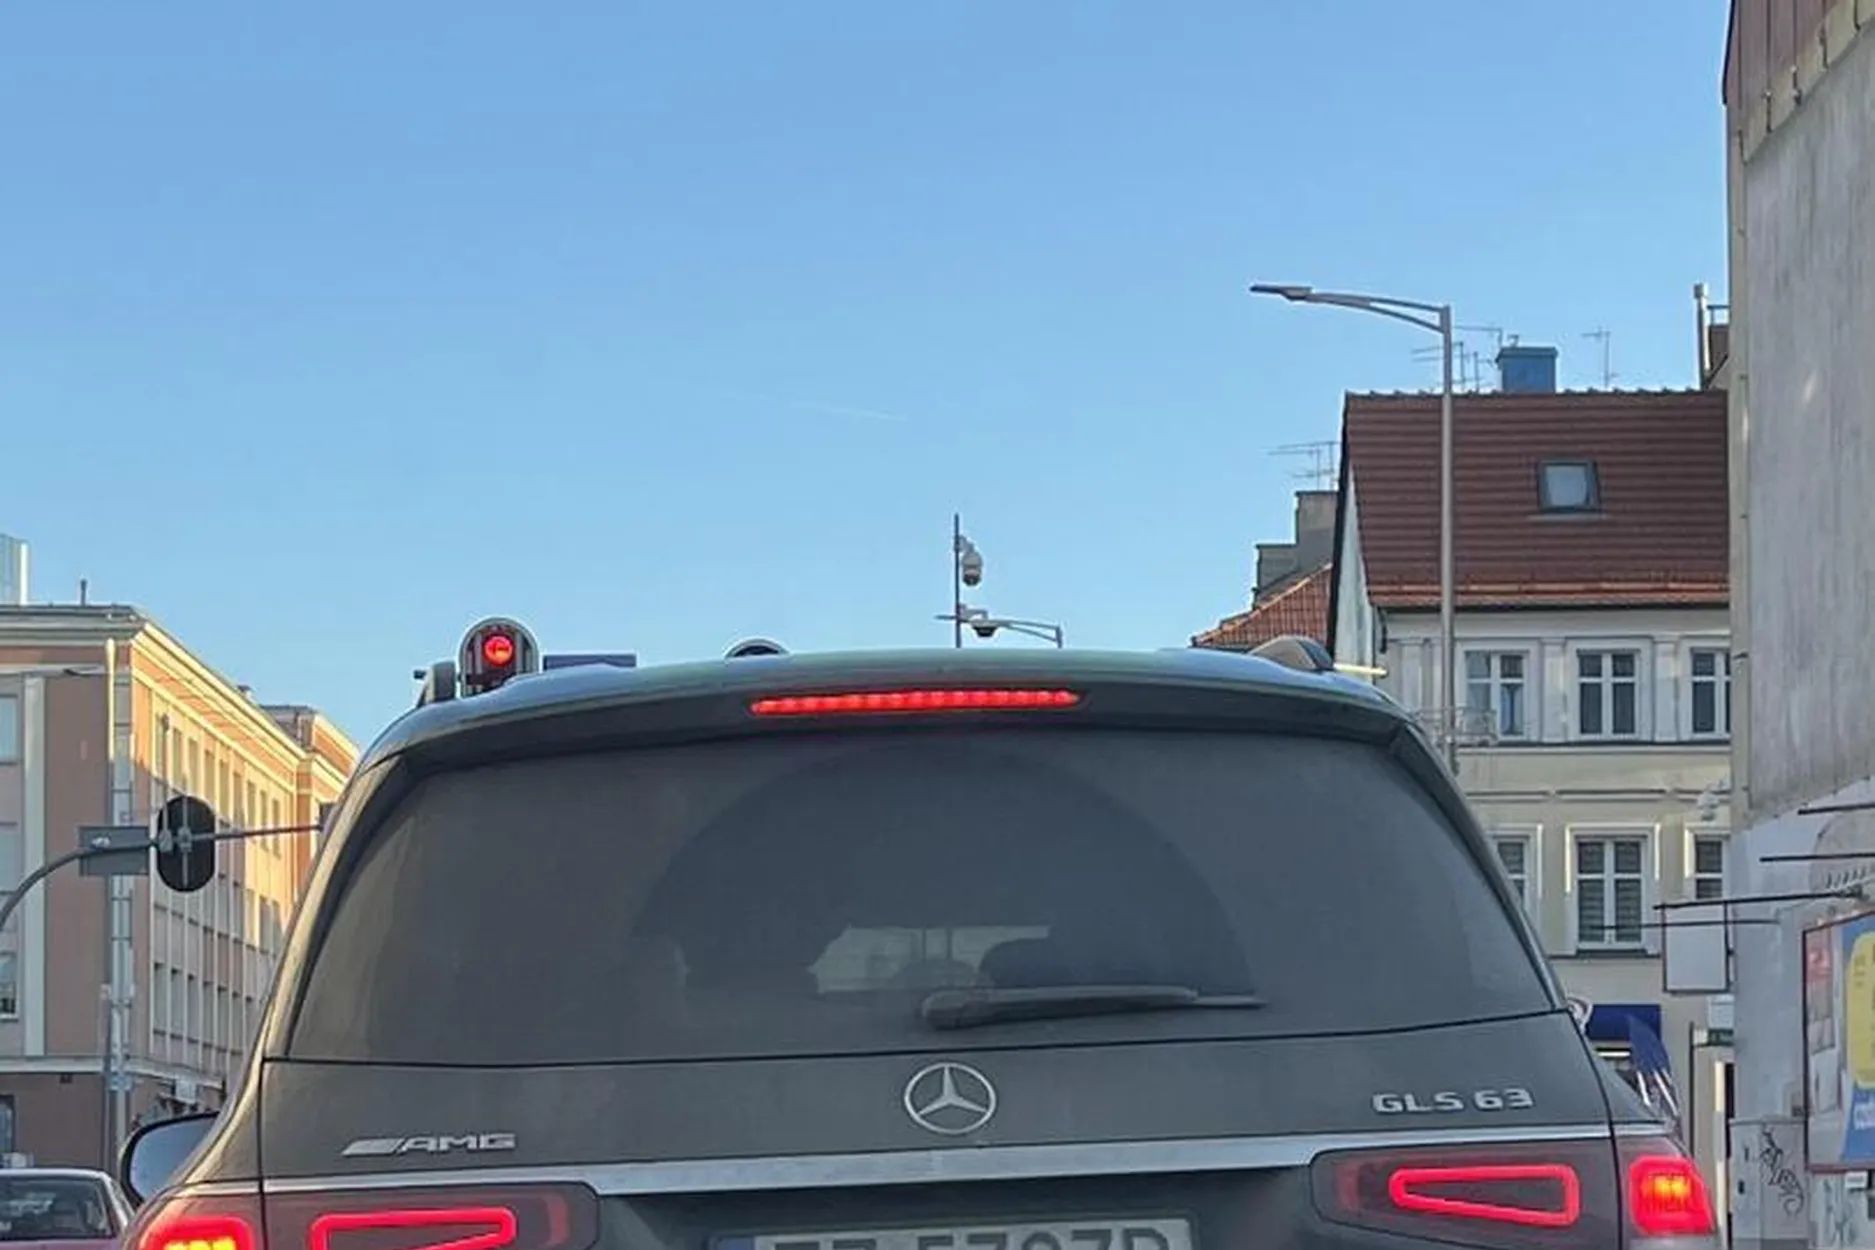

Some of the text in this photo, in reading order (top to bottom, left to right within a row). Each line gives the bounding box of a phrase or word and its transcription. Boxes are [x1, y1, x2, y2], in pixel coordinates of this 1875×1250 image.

[1372, 1088, 1534, 1113] GLS 63
[398, 1133, 516, 1153] AMG
